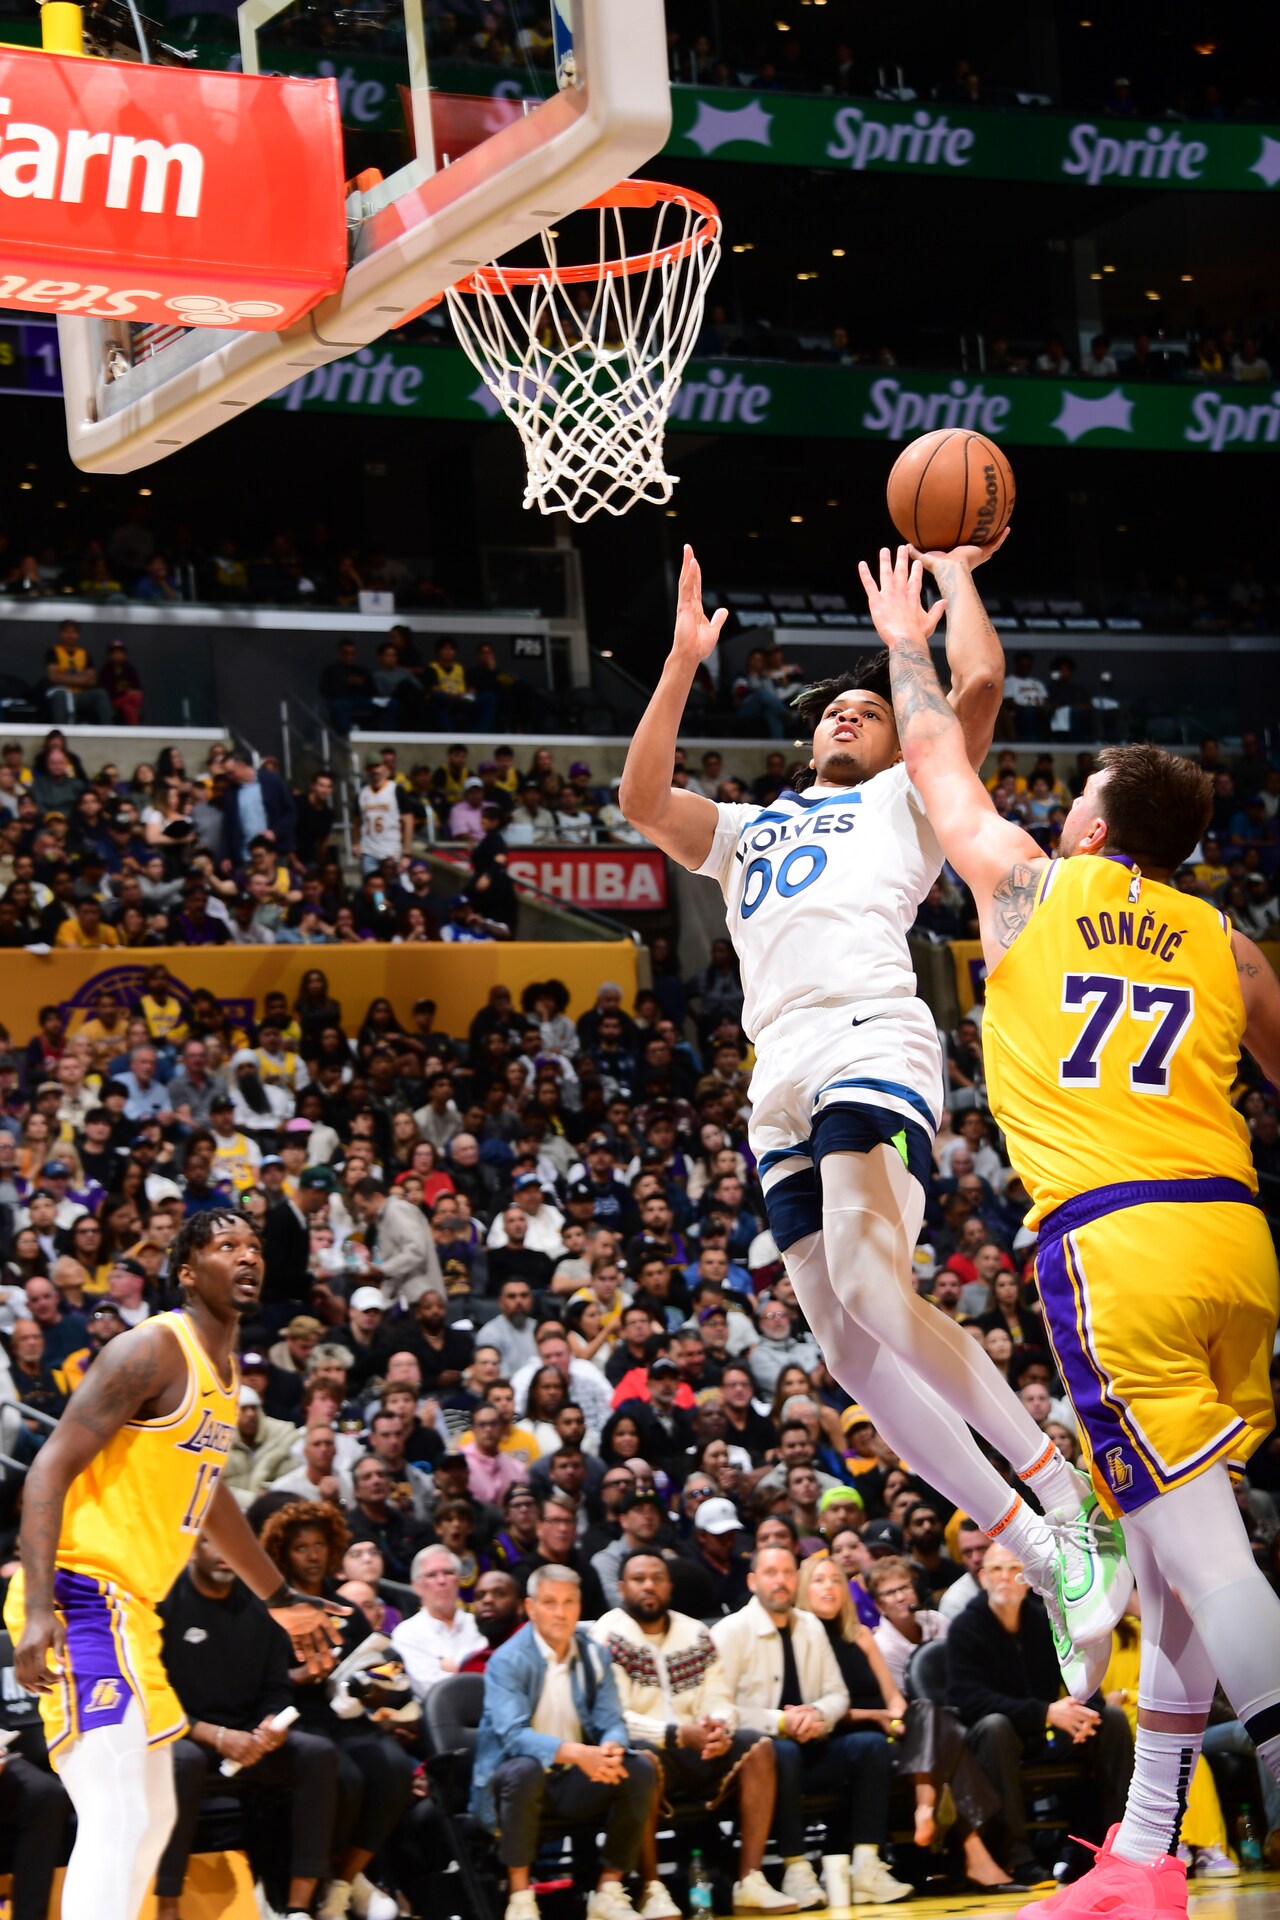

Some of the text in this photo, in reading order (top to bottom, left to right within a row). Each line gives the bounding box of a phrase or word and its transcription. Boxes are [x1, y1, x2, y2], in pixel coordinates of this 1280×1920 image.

[0, 97, 204, 218] arm
[826, 106, 975, 171] Sprite
[1062, 122, 1208, 186] Sprite
[268, 348, 424, 412] prite
[862, 377, 1011, 441] Sprite
[1184, 389, 1280, 453] Spri
[968, 463, 998, 545] Wilson
[506, 861, 663, 903] SHIBA
[741, 845, 828, 920] 00
[1076, 908, 1189, 963] DONČIĆ
[1058, 972, 1195, 1096] 77
